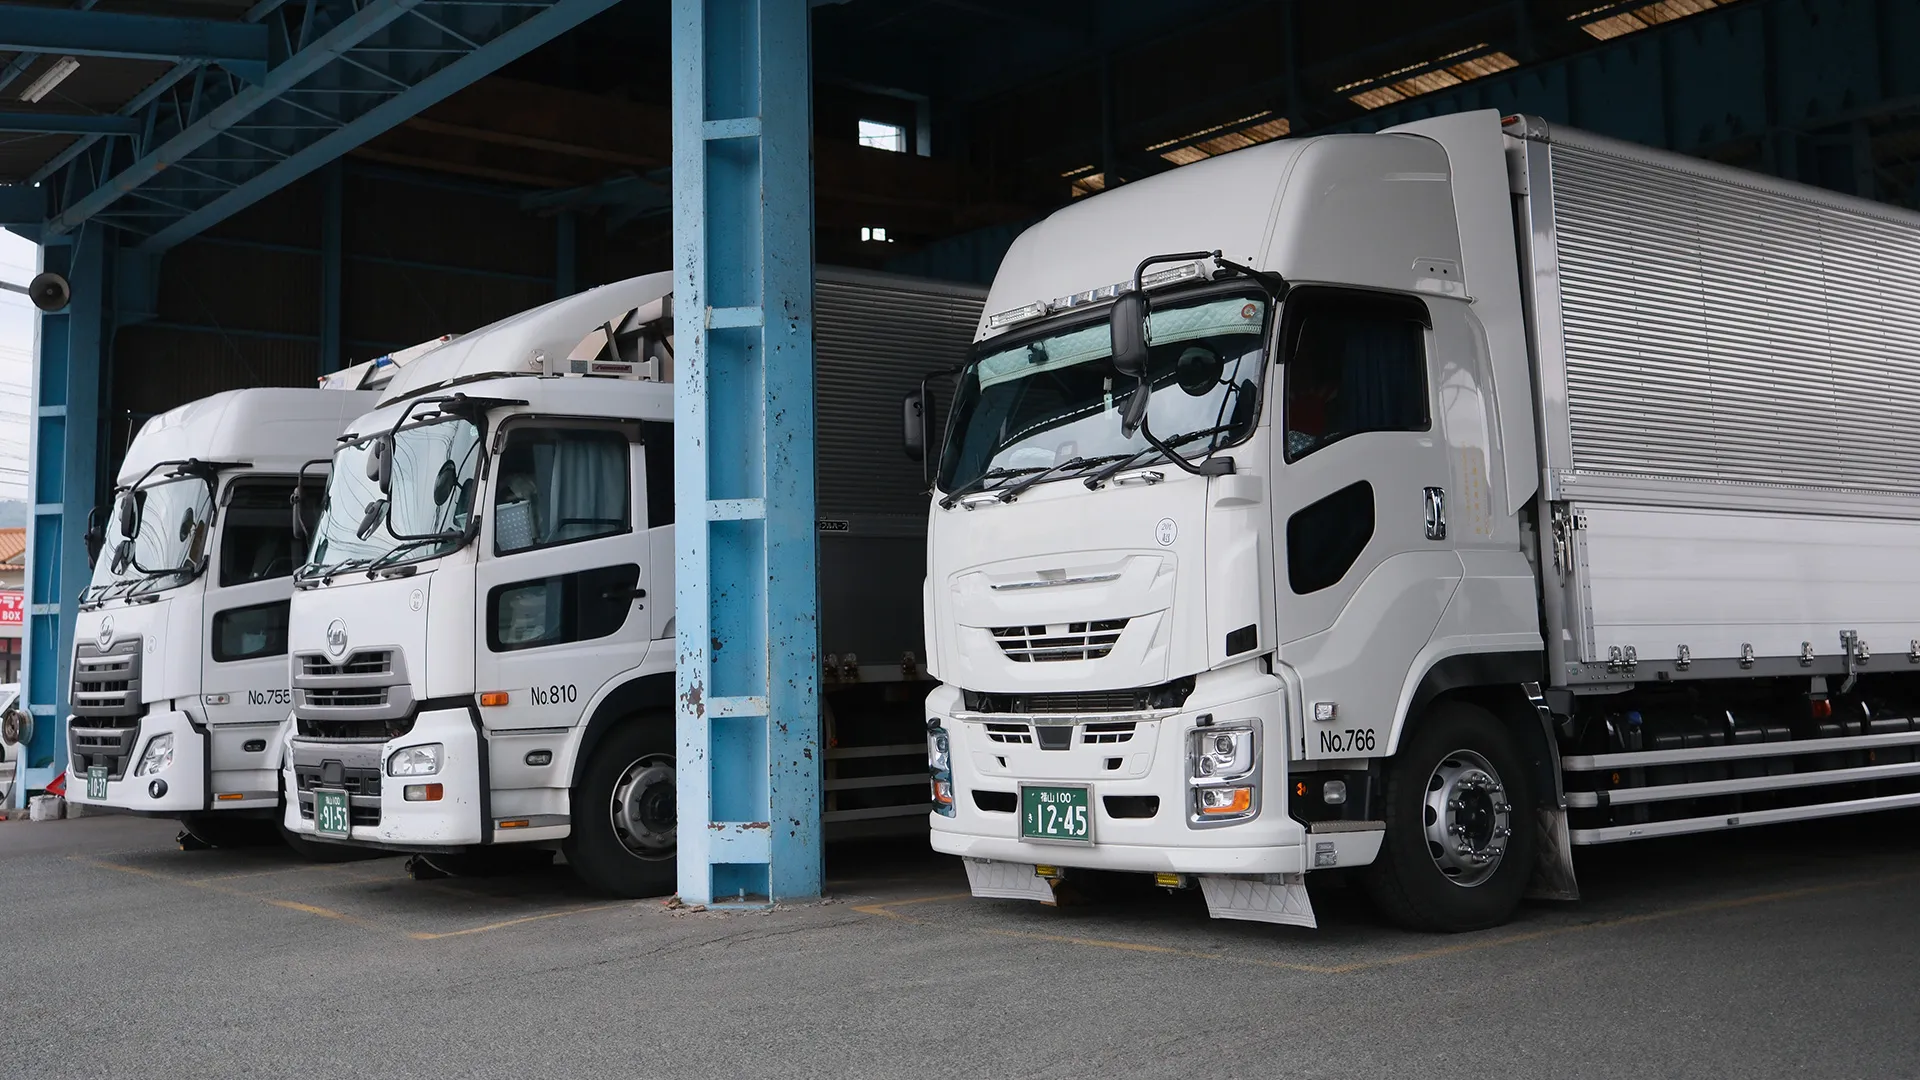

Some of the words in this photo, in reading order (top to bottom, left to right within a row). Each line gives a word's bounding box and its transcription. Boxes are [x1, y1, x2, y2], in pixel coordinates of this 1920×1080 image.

[2, 611, 21, 620] BOX
[248, 689, 291, 704] No.755
[531, 684, 577, 705] No.810
[1320, 728, 1375, 753] No.766
[323, 805, 347, 830] 91-53
[1038, 804, 1087, 836] 12-45
